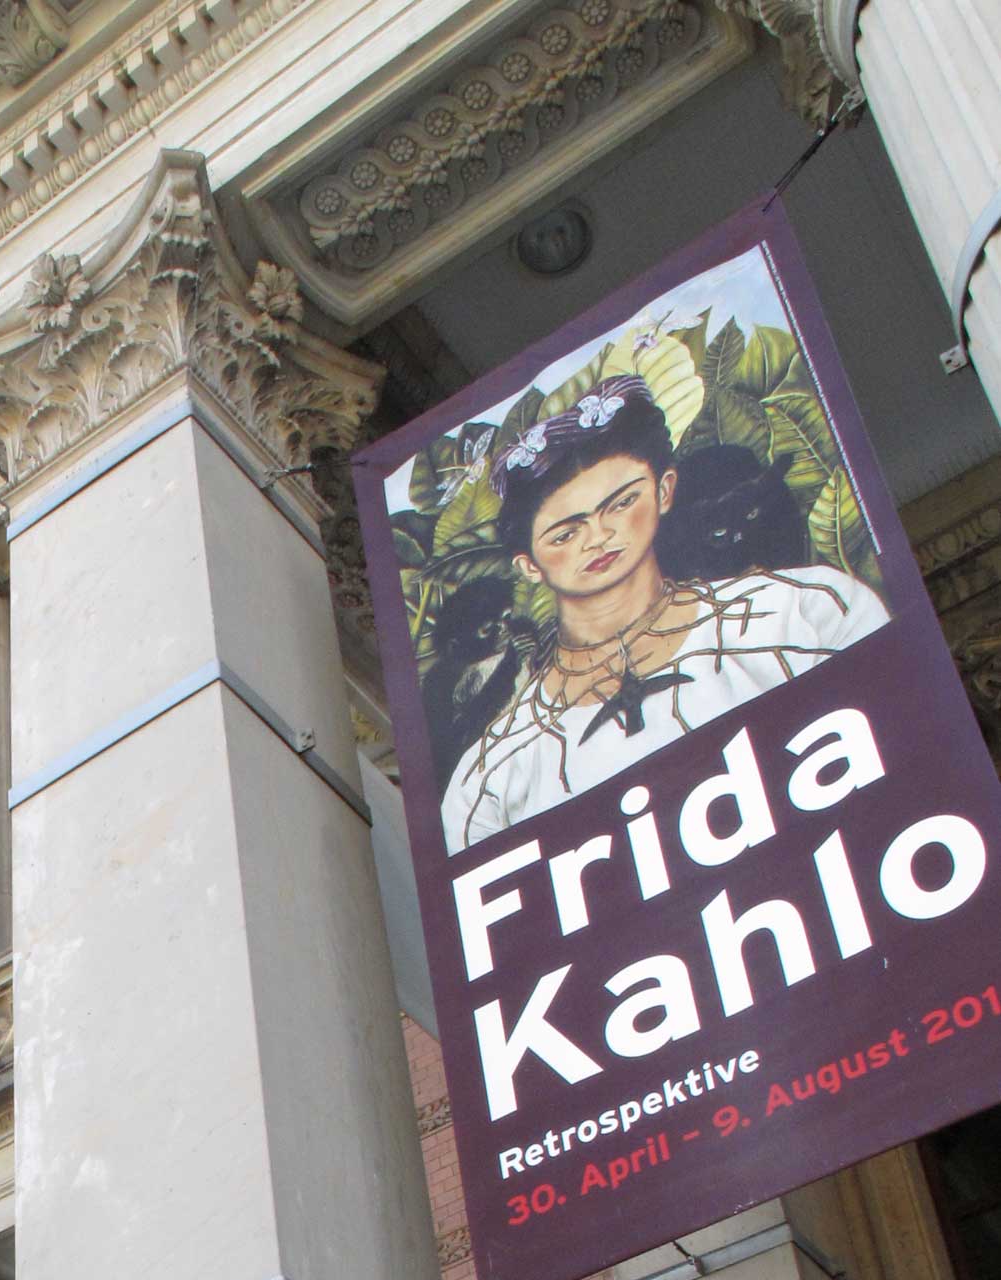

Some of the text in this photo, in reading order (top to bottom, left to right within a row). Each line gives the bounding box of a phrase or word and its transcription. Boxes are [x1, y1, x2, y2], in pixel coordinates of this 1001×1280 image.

[452, 708, 886, 982] Frida
[473, 814, 986, 1122] Kahlo
[499, 1049, 761, 1180] Retrospektive
[506, 1193, 568, 1226] 30.
[580, 1131, 671, 1196] April
[712, 1104, 751, 1138] 9.
[765, 1027, 911, 1117] August
